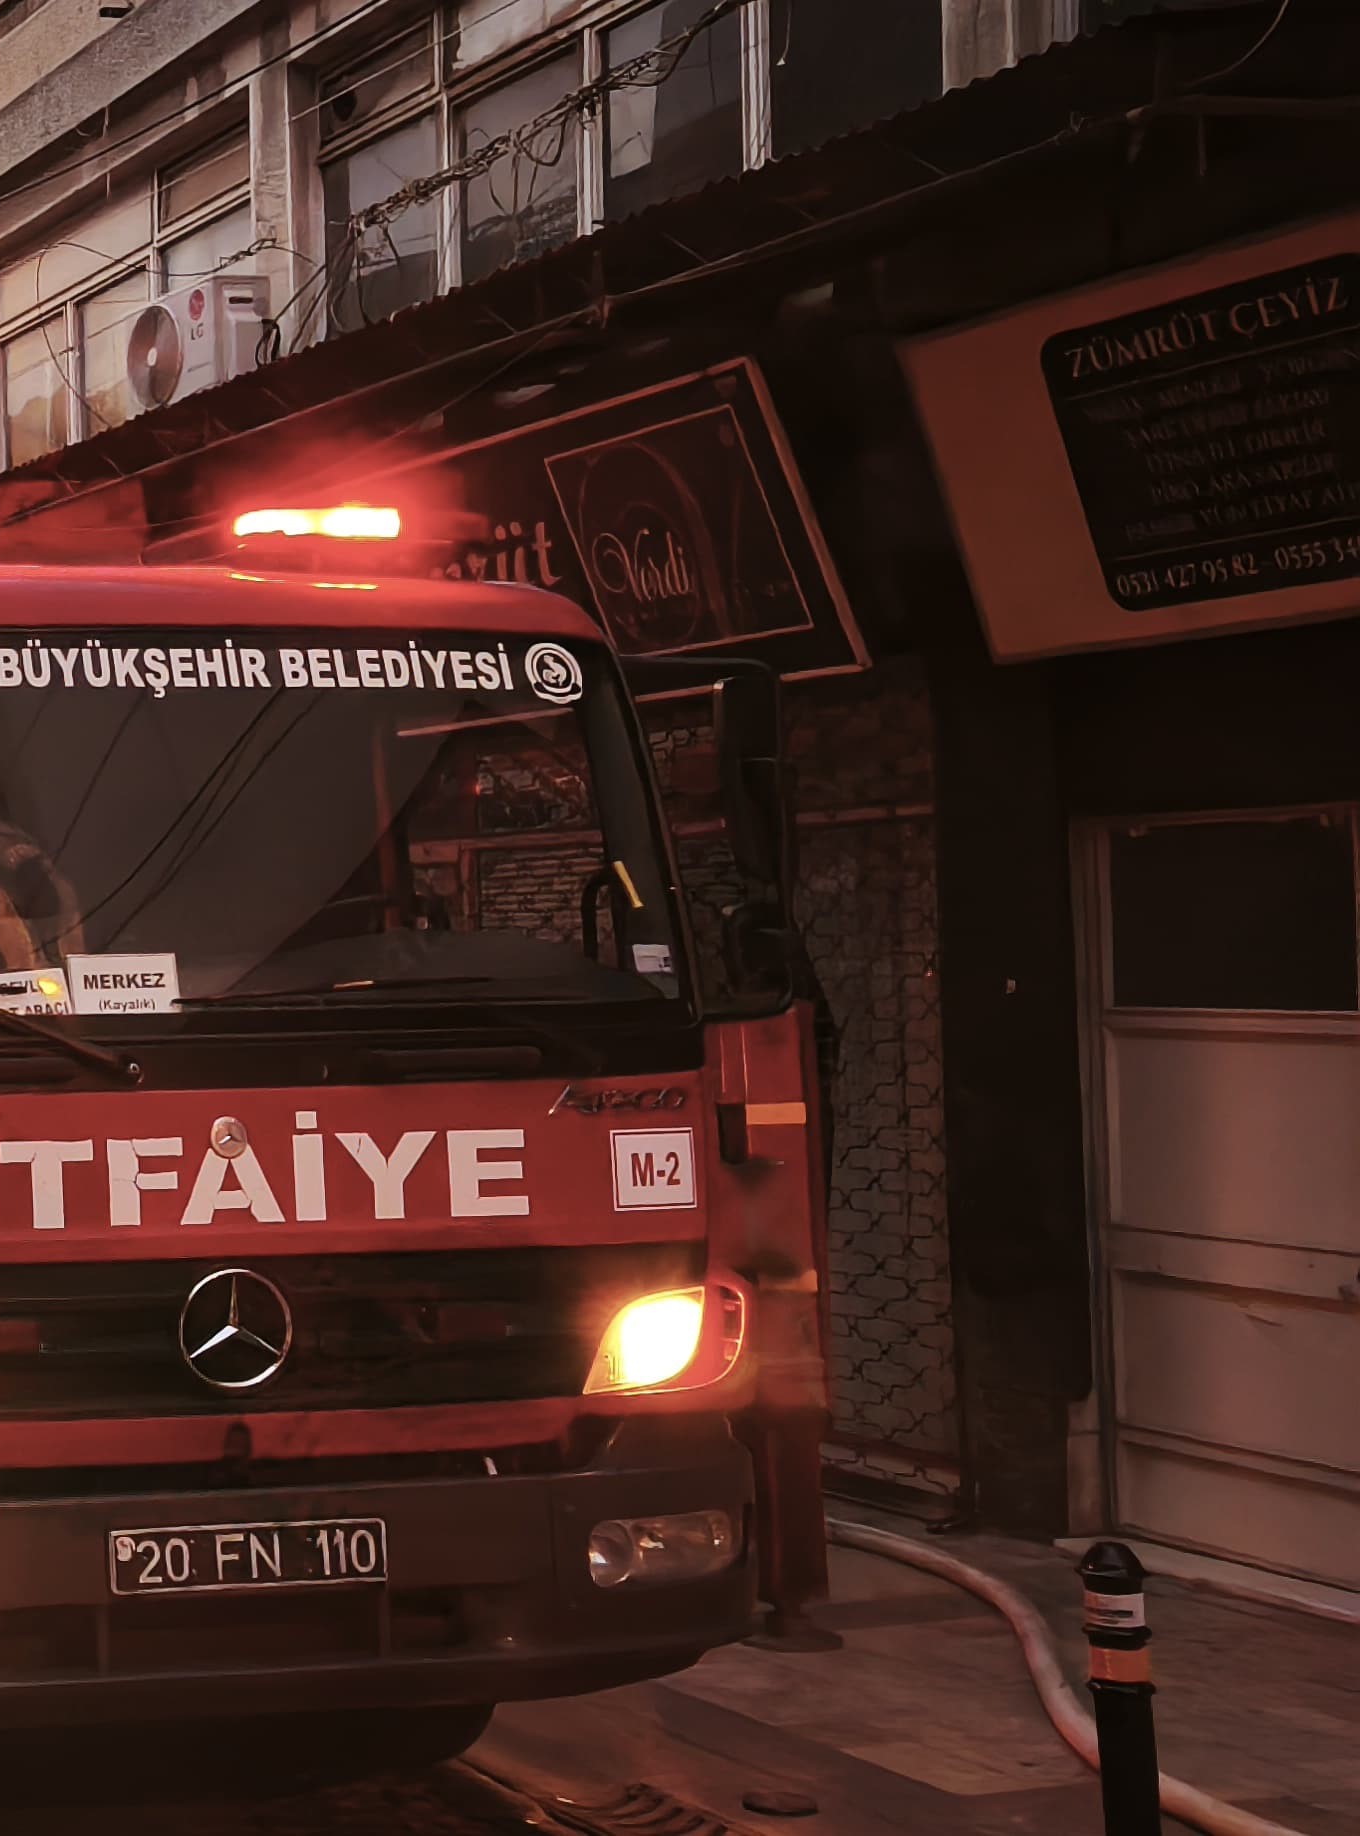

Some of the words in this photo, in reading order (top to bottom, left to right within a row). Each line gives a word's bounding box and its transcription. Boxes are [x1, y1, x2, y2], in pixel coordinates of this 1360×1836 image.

[189, 322, 205, 341] LG
[1064, 311, 1218, 380] ZÜMRÜT
[1228, 276, 1348, 340] ÇEYİZ
[1274, 541, 1327, 570] 0555
[280, 640, 515, 692] BELEDİYESİ
[82, 973, 166, 990] MERKEZ
[631, 1153, 682, 1188] M-2
[136, 1537, 191, 1585] 20
[214, 1532, 283, 1582] FN
[315, 1528, 377, 1576] 110
